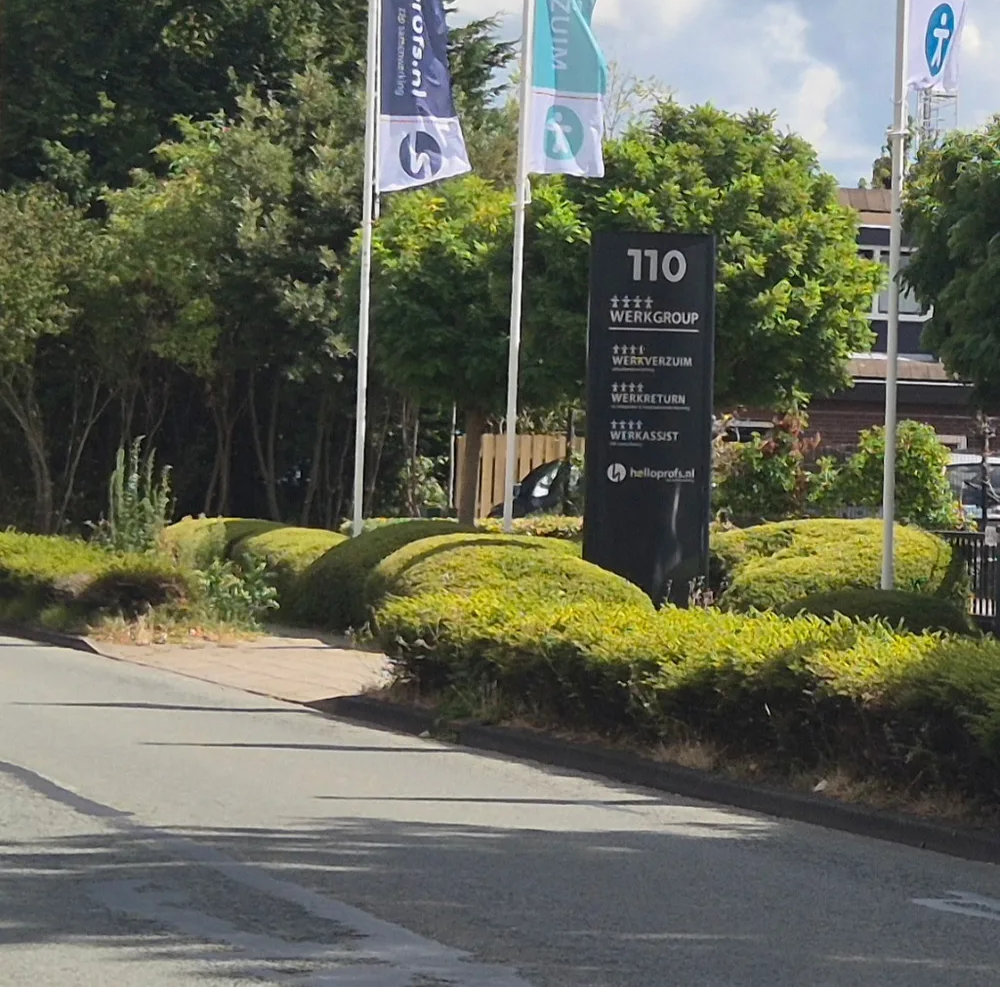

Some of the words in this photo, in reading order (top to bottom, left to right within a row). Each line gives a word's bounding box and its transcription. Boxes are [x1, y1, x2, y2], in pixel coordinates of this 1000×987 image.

[627, 248, 687, 283] 110
[609, 309, 699, 325] WERKGROUP
[611, 355, 693, 367] WERKVERZUIM
[610, 393, 687, 405] WERKRETURN
[609, 430, 679, 442] WERKASSIST
[630, 467, 695, 481] helloprofs.nl
